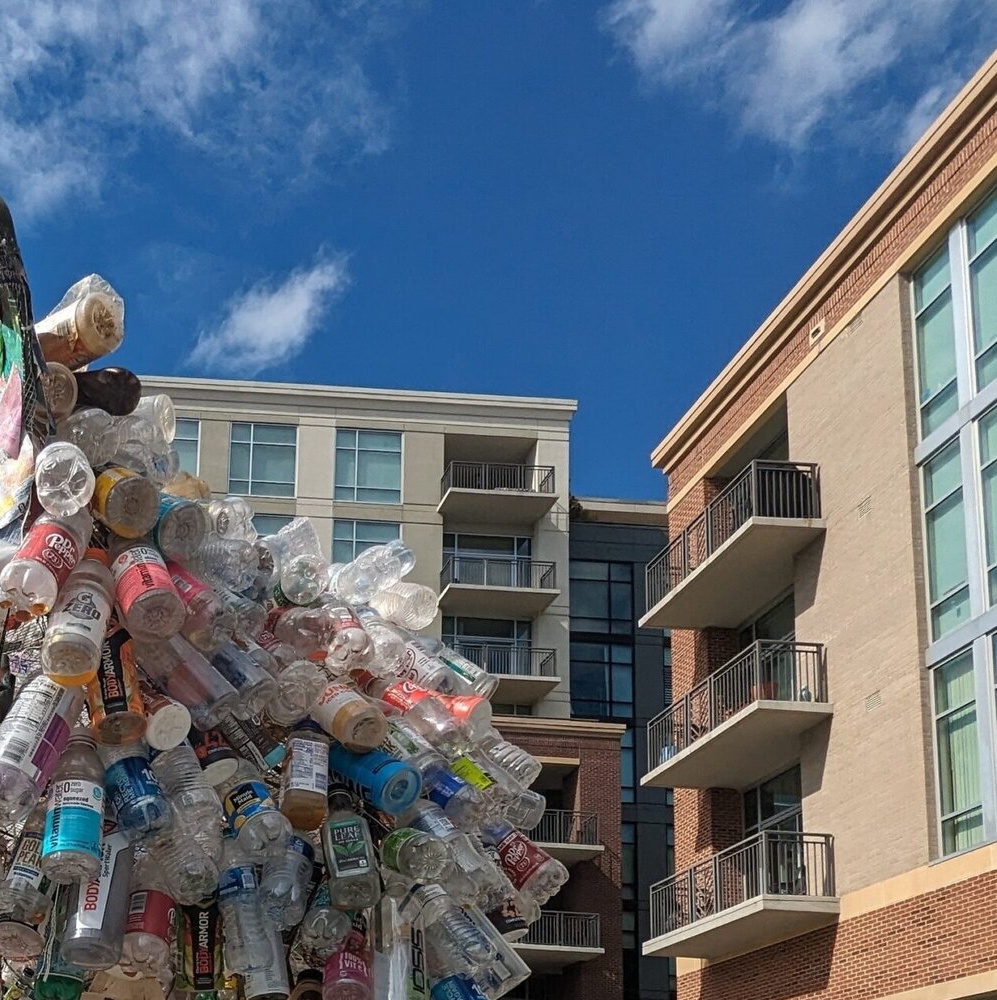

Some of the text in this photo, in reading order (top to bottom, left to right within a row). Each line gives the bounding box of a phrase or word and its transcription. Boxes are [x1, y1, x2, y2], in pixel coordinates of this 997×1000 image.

[46, 533, 76, 569] Dr Pepper
[62, 602, 101, 622] ZERO
[334, 825, 361, 836] PURE
[335, 832, 360, 842] LEAF
[16, 850, 42, 869] PEAK
[504, 843, 526, 866] Pepper
[199, 911, 210, 974] BODYARMOR
